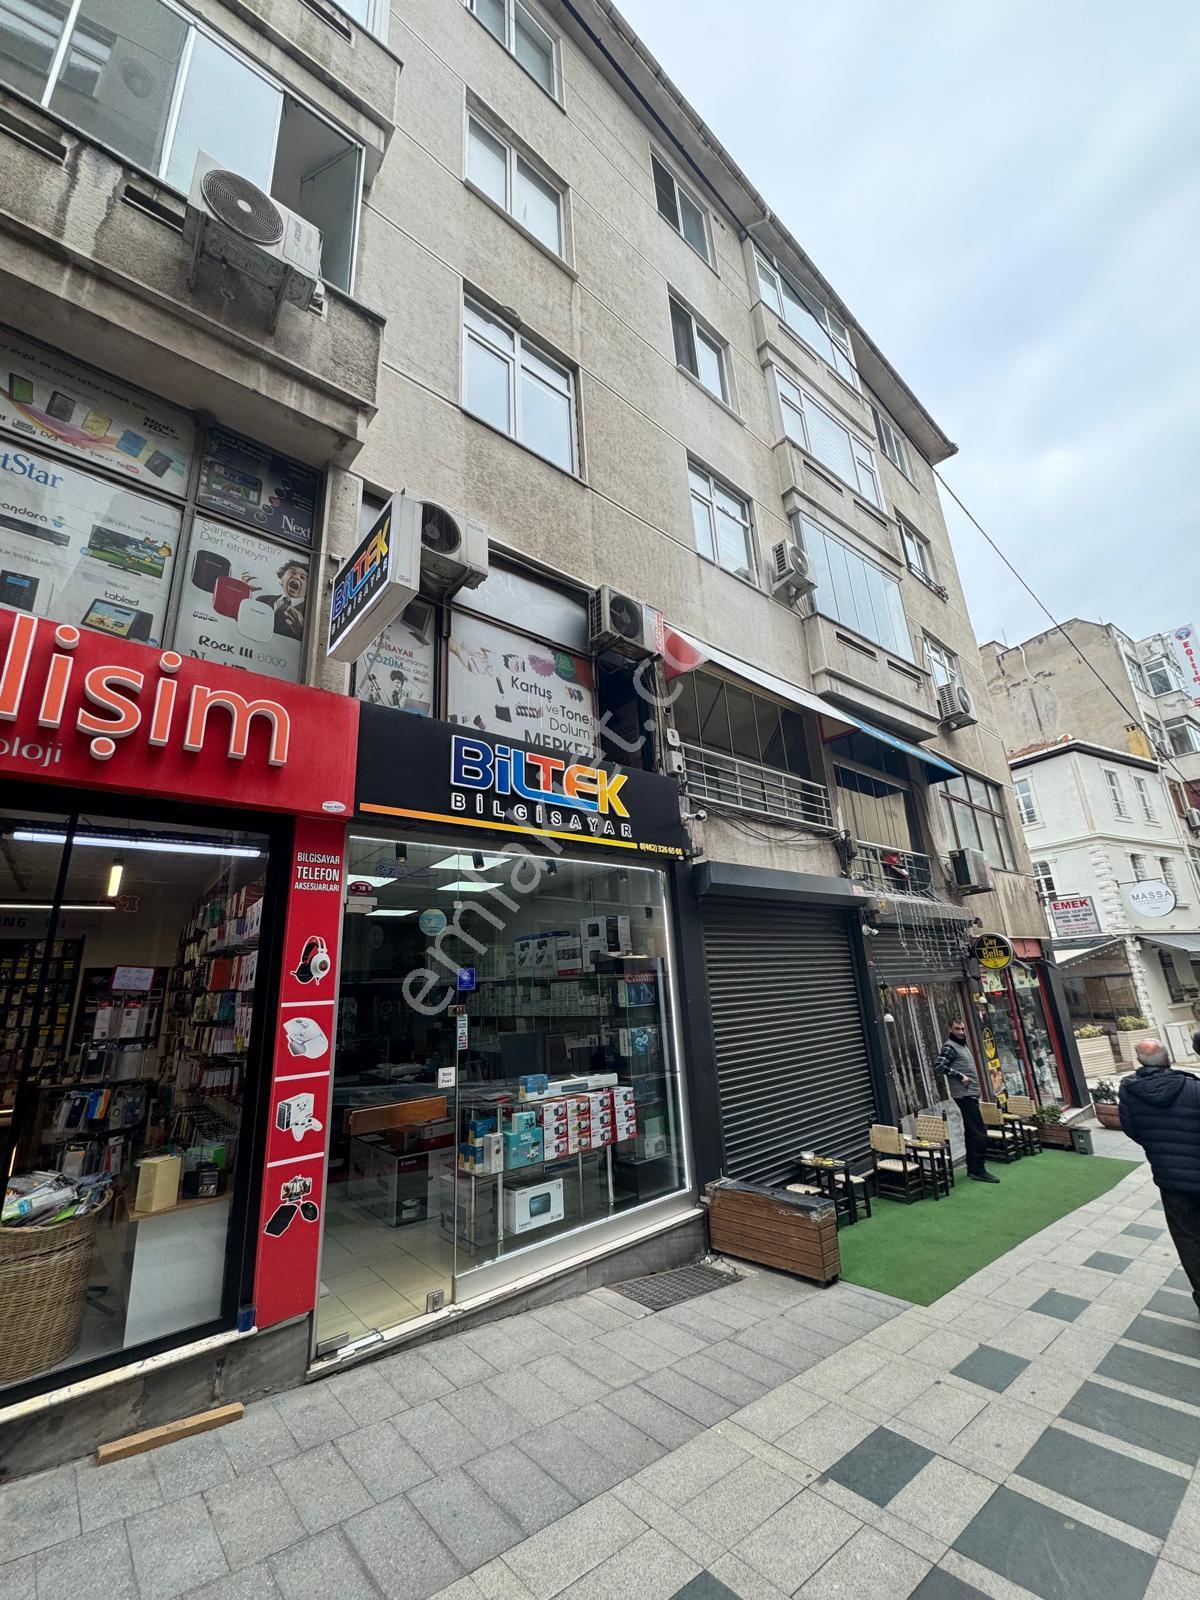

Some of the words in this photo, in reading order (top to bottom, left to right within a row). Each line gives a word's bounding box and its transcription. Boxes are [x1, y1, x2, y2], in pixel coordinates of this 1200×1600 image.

[0, 502, 48, 524] andora
[281, 514, 312, 540] Next
[511, 675, 553, 703] Kartuş
[545, 704, 559, 715] ve
[550, 717, 591, 741] Dolum
[297, 850, 341, 865] BİLGİSAYAR
[296, 865, 341, 882] TELEFON
[294, 881, 340, 892] AKSESUARLARI
[1131, 890, 1173, 901] MASSA
[1052, 898, 1090, 911] EMEK
[981, 947, 1005, 959] Bella
